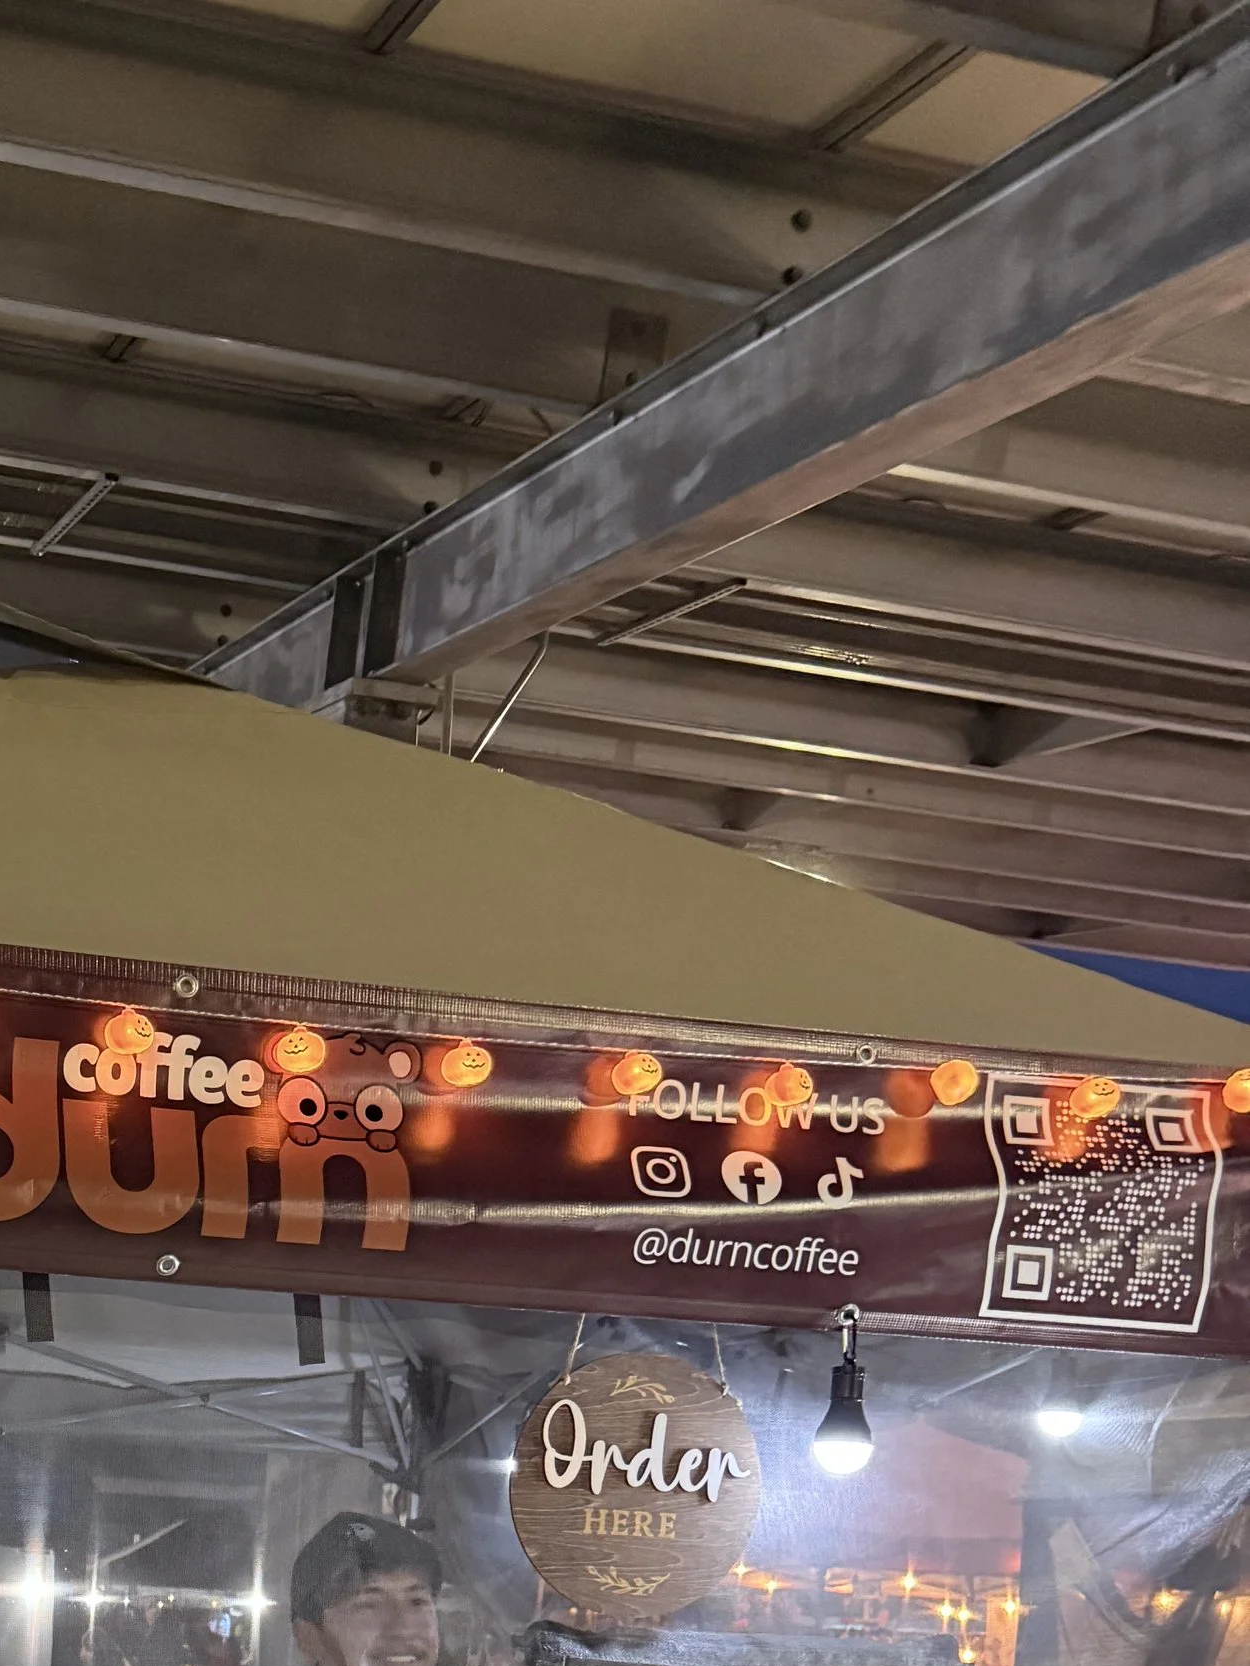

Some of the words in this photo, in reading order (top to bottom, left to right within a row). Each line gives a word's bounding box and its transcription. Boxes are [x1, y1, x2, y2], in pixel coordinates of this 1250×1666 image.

[62, 1031, 265, 1108] coffee
[829, 1094, 886, 1136] US
[632, 1226, 861, 1277] @durncoffee
[542, 1398, 752, 1504] Order
[582, 1507, 678, 1540] HERE
